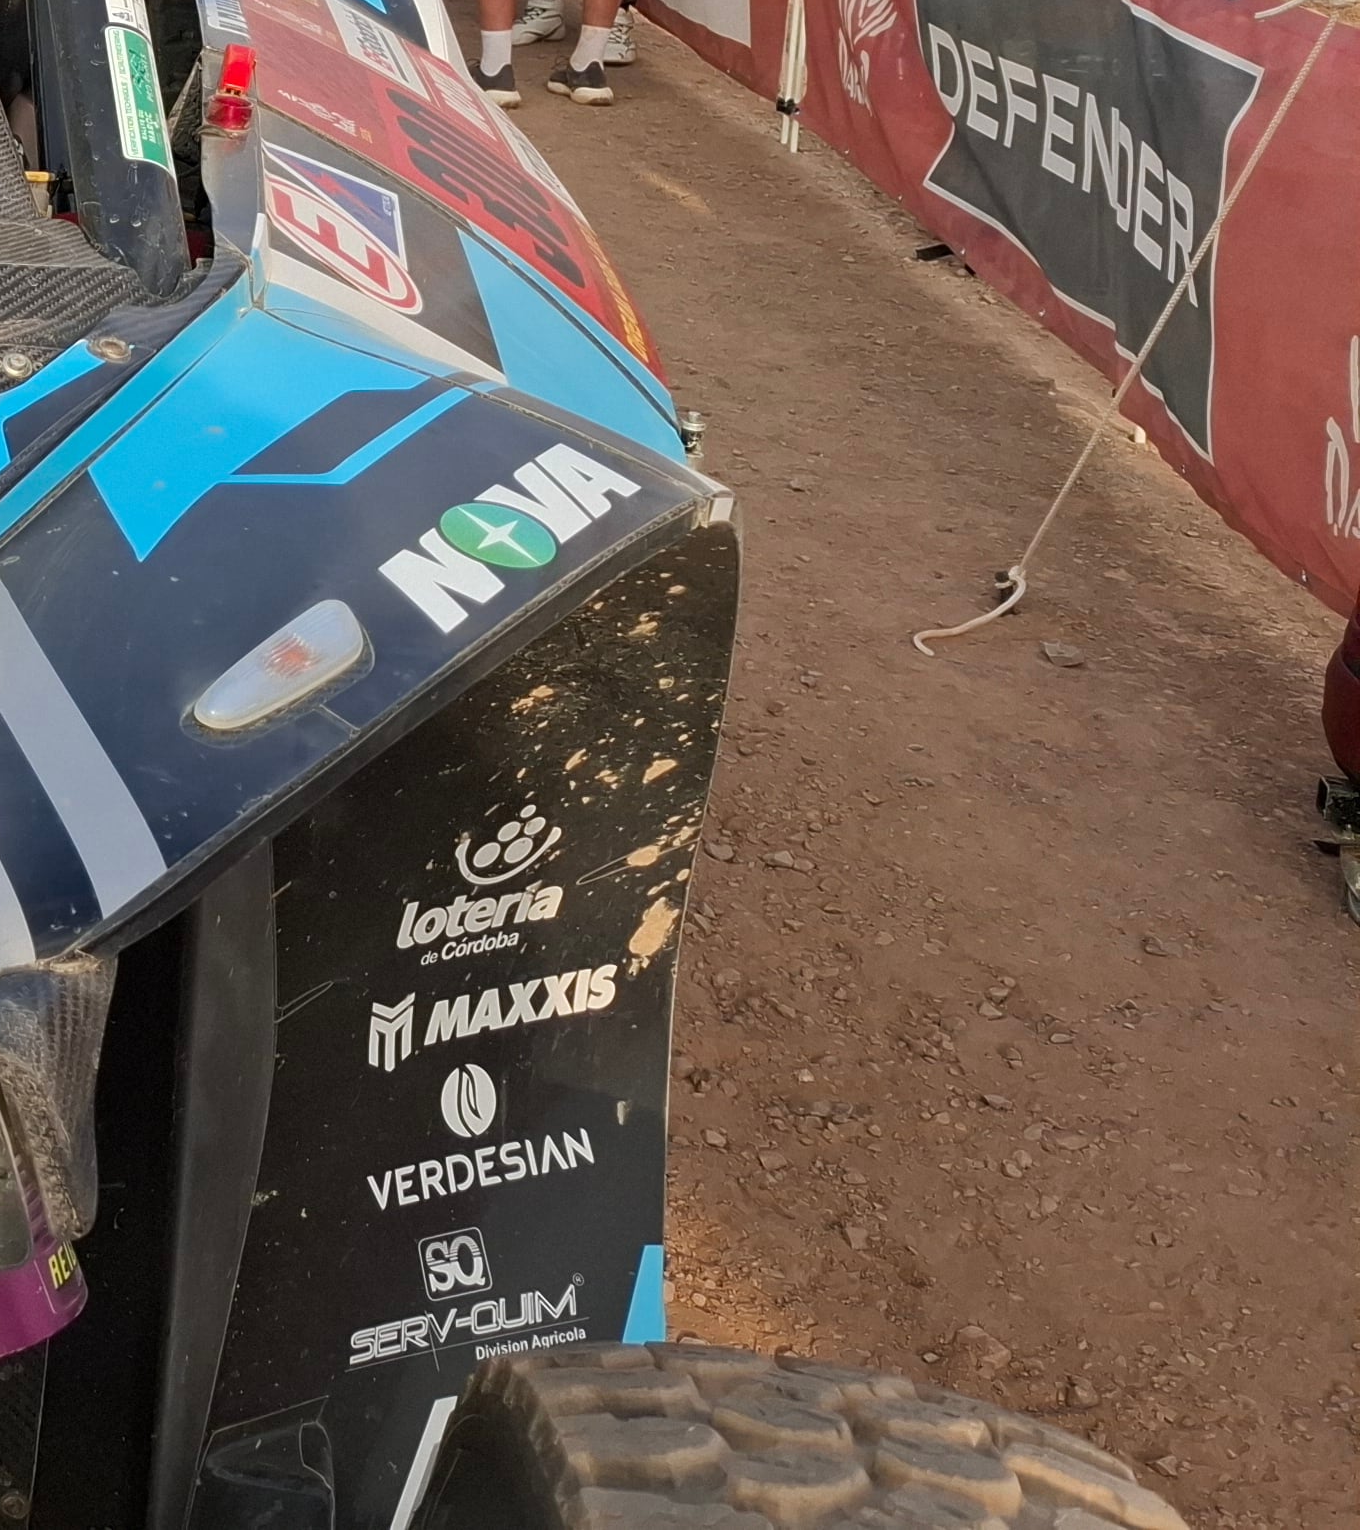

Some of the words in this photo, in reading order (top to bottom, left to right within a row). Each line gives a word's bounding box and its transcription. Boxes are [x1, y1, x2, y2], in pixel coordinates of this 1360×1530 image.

[927, 22, 1201, 308] DEFENDER
[377, 442, 642, 638] NOVA
[419, 949, 438, 967] de
[440, 930, 521, 961] Córdoba
[423, 965, 617, 1047] MAXXIS
[366, 1128, 596, 1212] VERDESIAN
[424, 1232, 486, 1296] SQ
[349, 1281, 579, 1367] SERV-QUIM
[474, 1339, 529, 1361] Division
